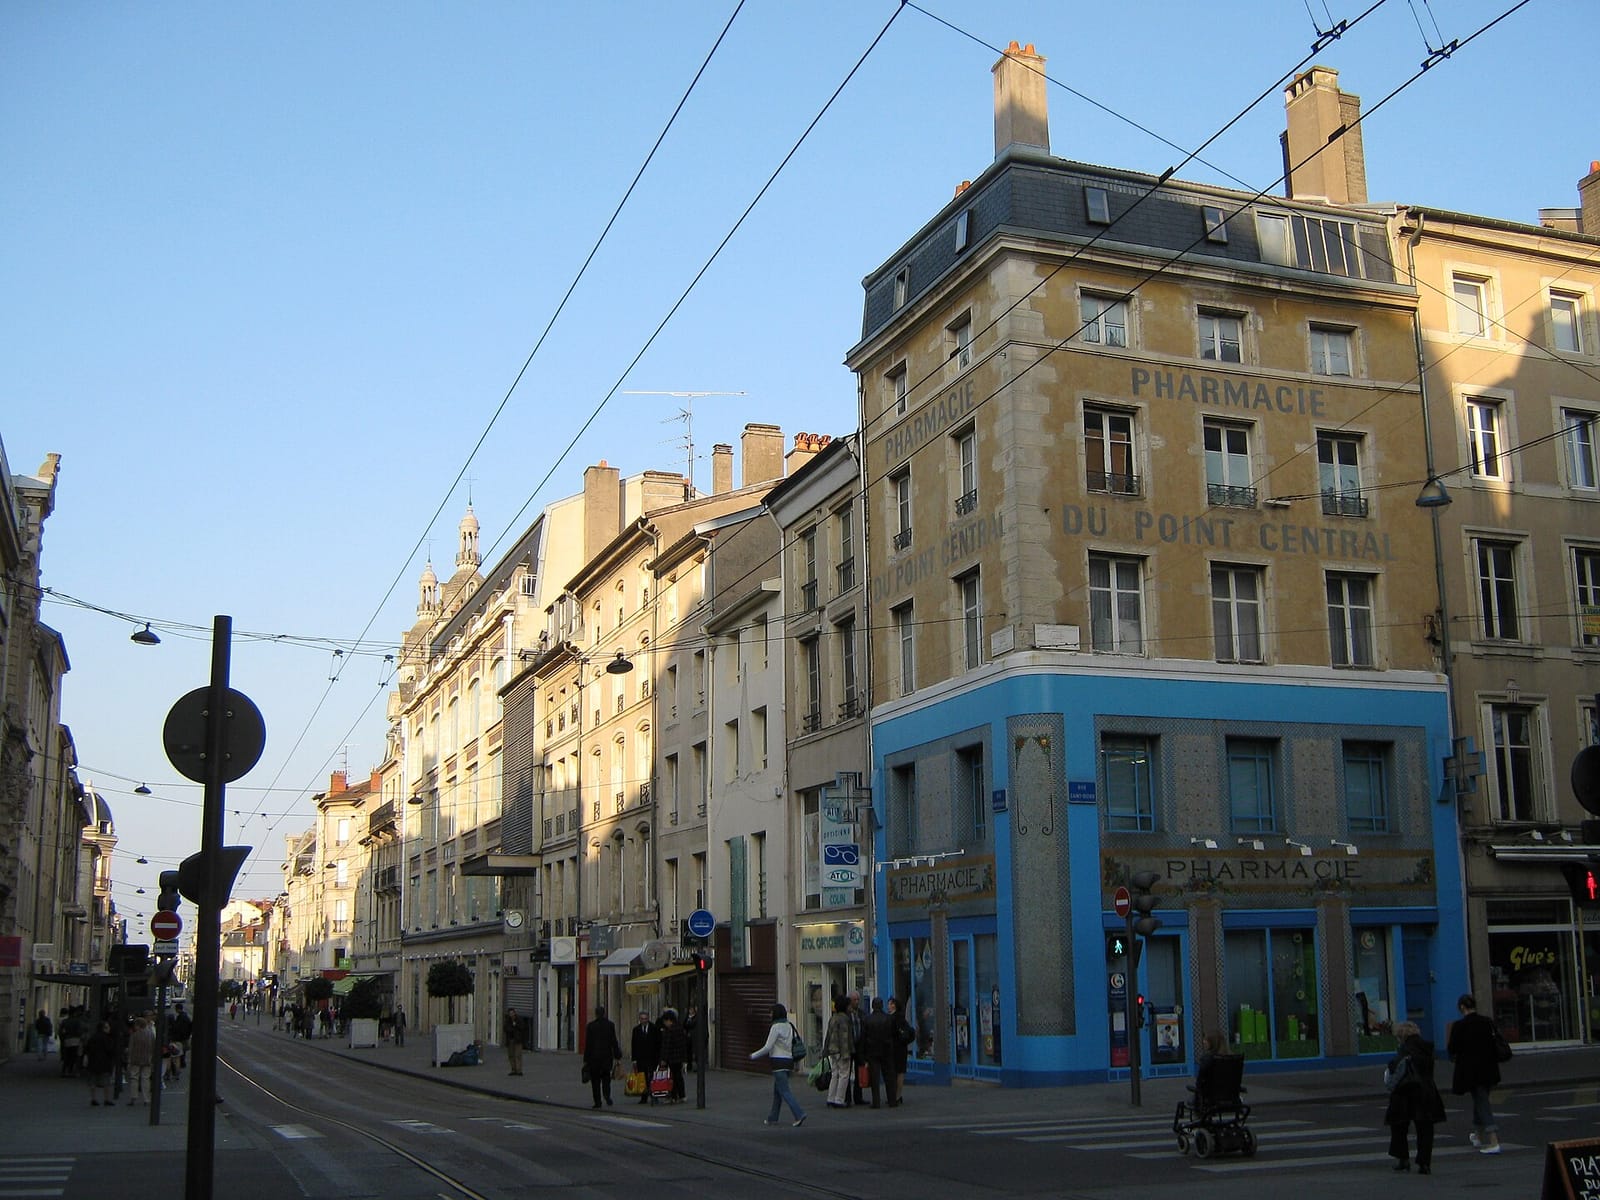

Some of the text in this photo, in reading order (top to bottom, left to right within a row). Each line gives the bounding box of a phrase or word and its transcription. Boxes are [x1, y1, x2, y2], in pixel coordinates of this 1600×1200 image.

[1131, 367, 1326, 417] PHARMACIE
[885, 379, 975, 464] PHARMACIE
[873, 510, 1004, 603] DU POINT CENTRAL
[1062, 504, 1398, 562] DU POINT CENTRAL
[830, 871, 855, 881] ATOL
[900, 868, 978, 895] PHARMACIE
[1165, 860, 1364, 880] PHARMACIE
